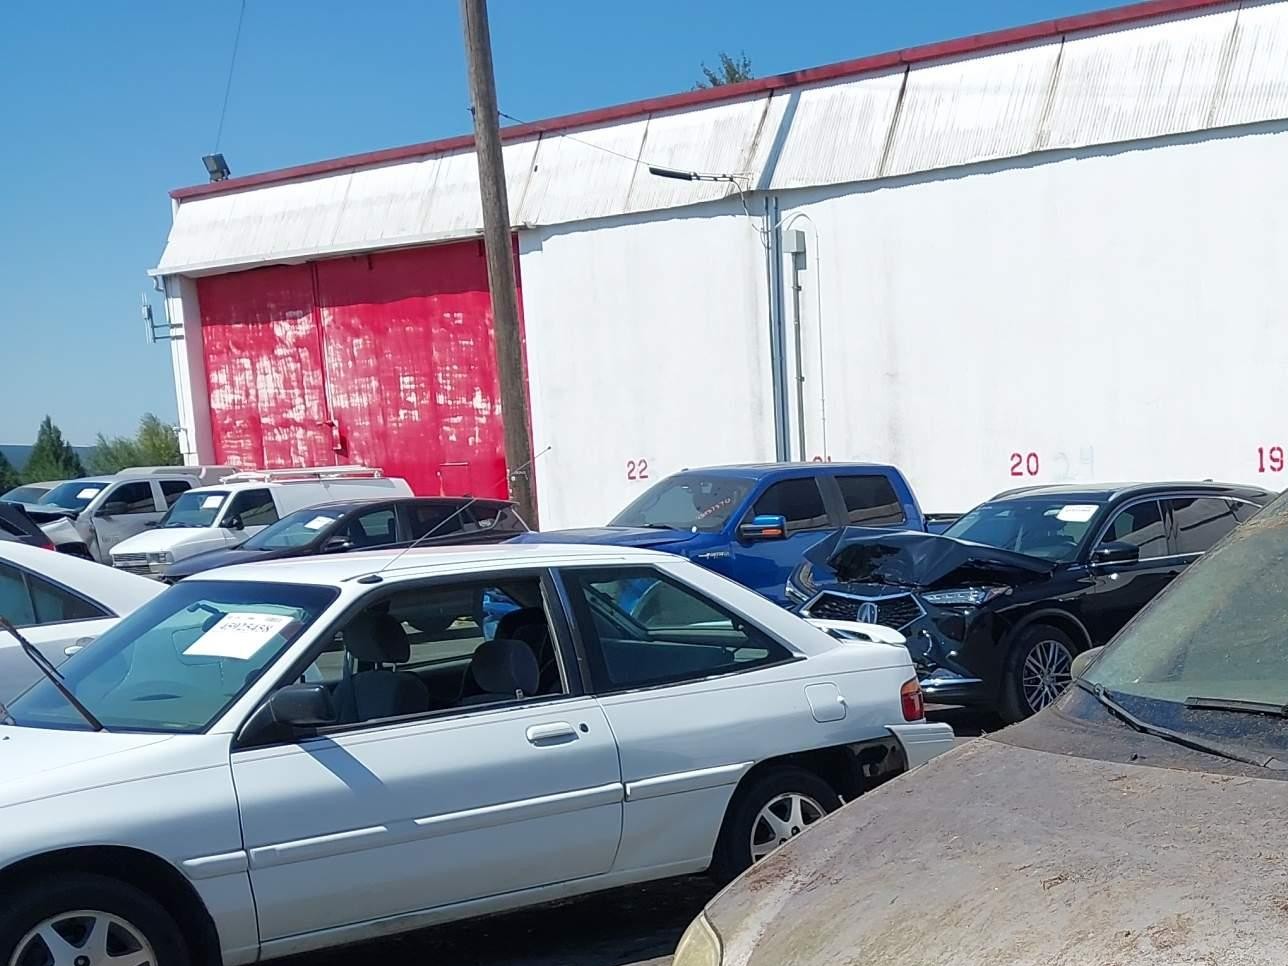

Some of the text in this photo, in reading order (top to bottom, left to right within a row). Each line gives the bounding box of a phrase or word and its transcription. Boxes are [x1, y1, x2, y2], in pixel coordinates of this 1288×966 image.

[626, 459, 649, 480] 22
[1009, 451, 1040, 477] 20
[1257, 445, 1285, 473] 19
